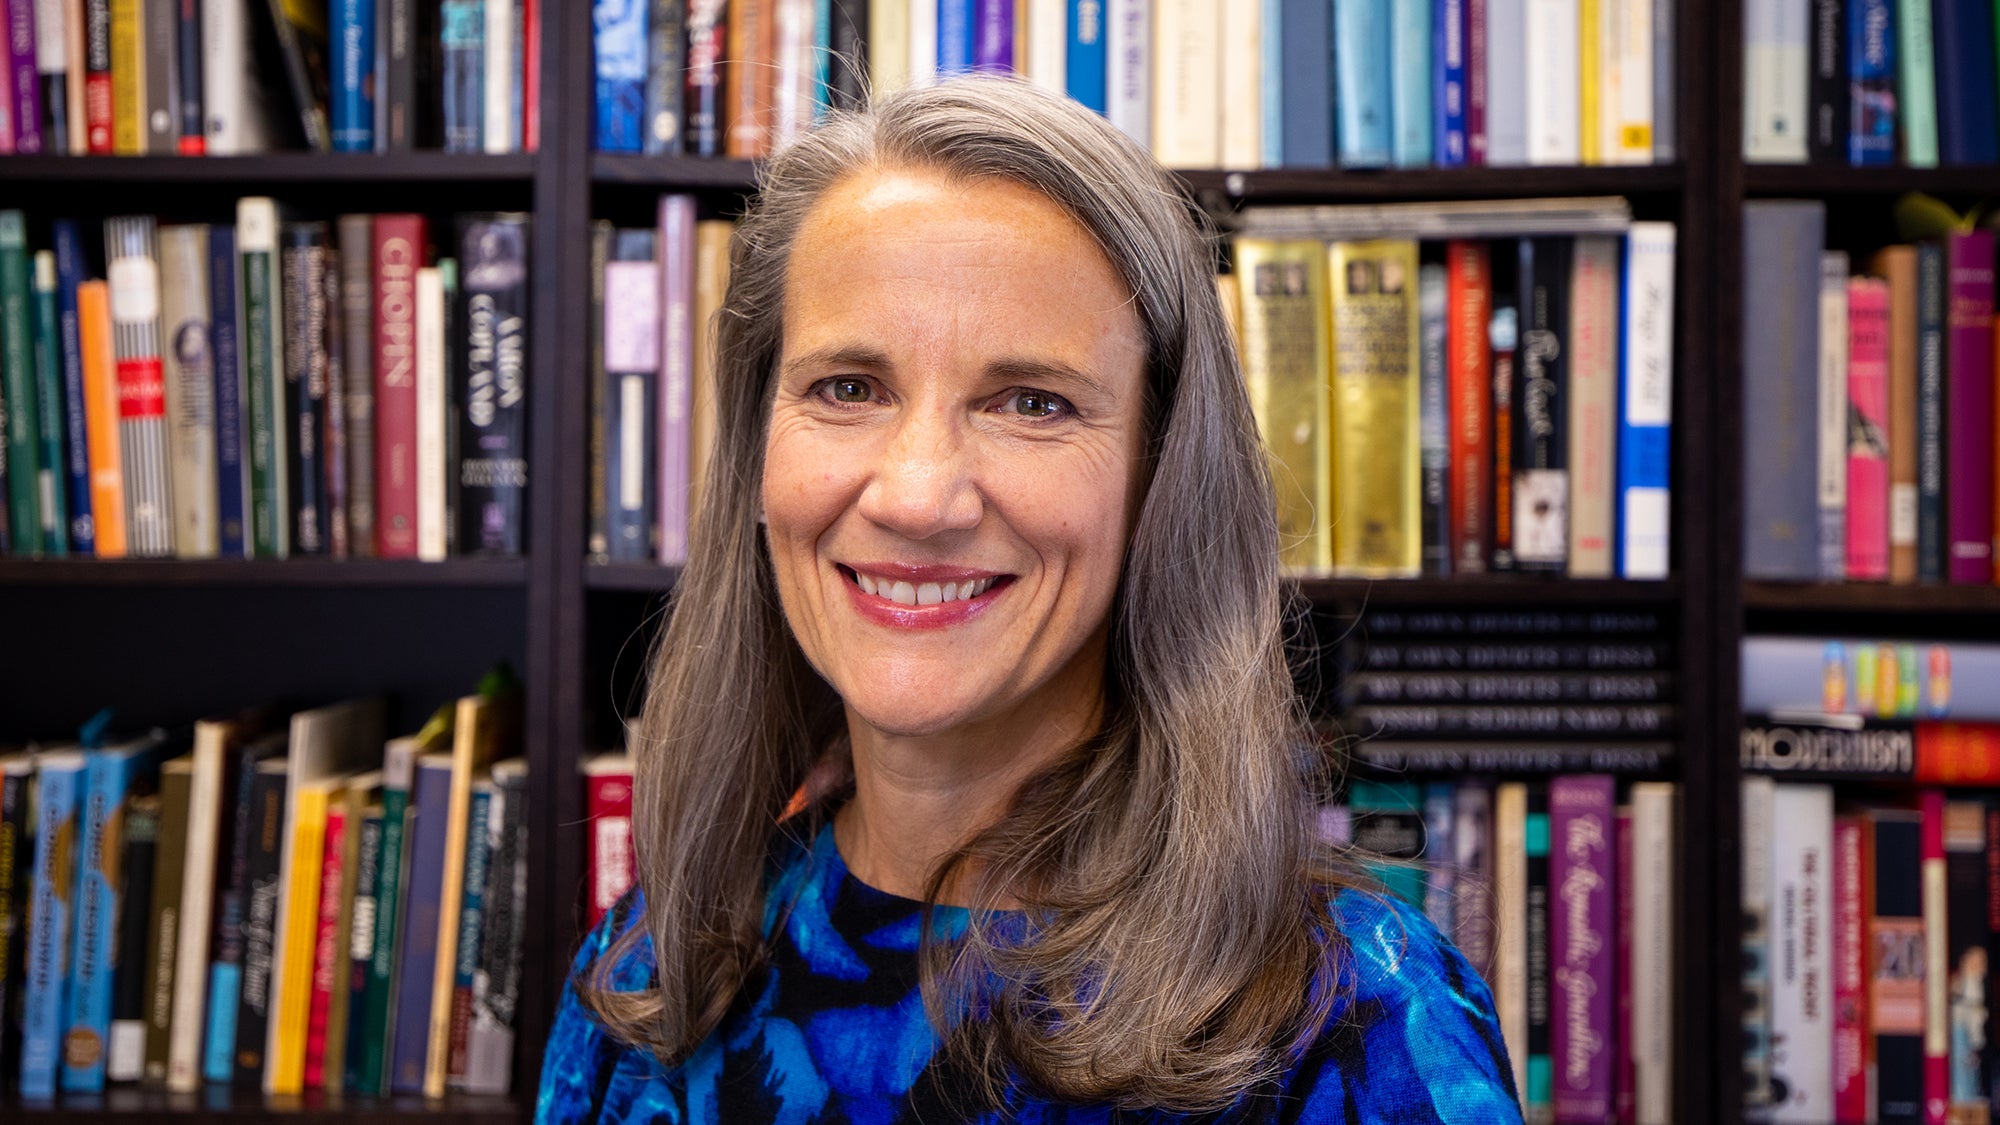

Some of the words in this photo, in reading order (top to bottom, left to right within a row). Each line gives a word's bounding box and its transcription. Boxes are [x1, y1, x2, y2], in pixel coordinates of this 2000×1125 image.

[381, 236, 414, 389] CHOPIN
[467, 293, 496, 427] COPLAND
[497, 315, 525, 408] AARON
[1739, 727, 1914, 771] MODERNISM
[1565, 814, 1606, 863] The
[1560, 862, 1605, 968] Romantic
[1555, 964, 1604, 1090] Generation
